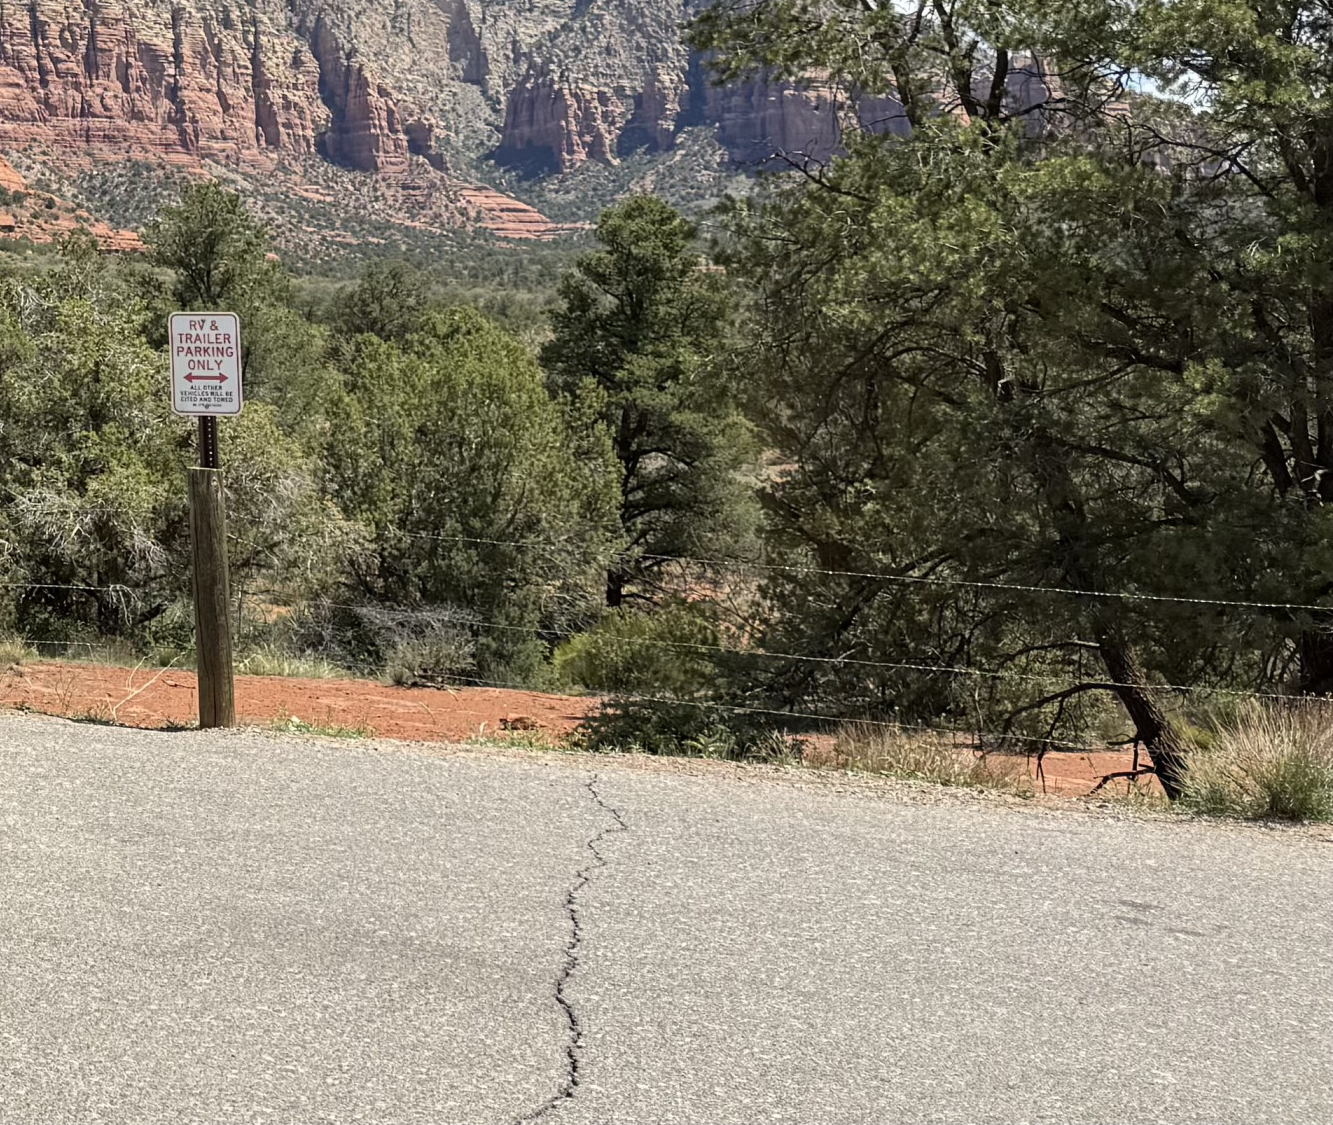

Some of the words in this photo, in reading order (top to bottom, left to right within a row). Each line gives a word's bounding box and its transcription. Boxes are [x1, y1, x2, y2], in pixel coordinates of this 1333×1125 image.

[189, 319, 206, 331] RV
[209, 319, 219, 331] &
[177, 333, 231, 344] TRAILER
[176, 346, 234, 357] PARKING
[188, 359, 223, 371] ONLY
